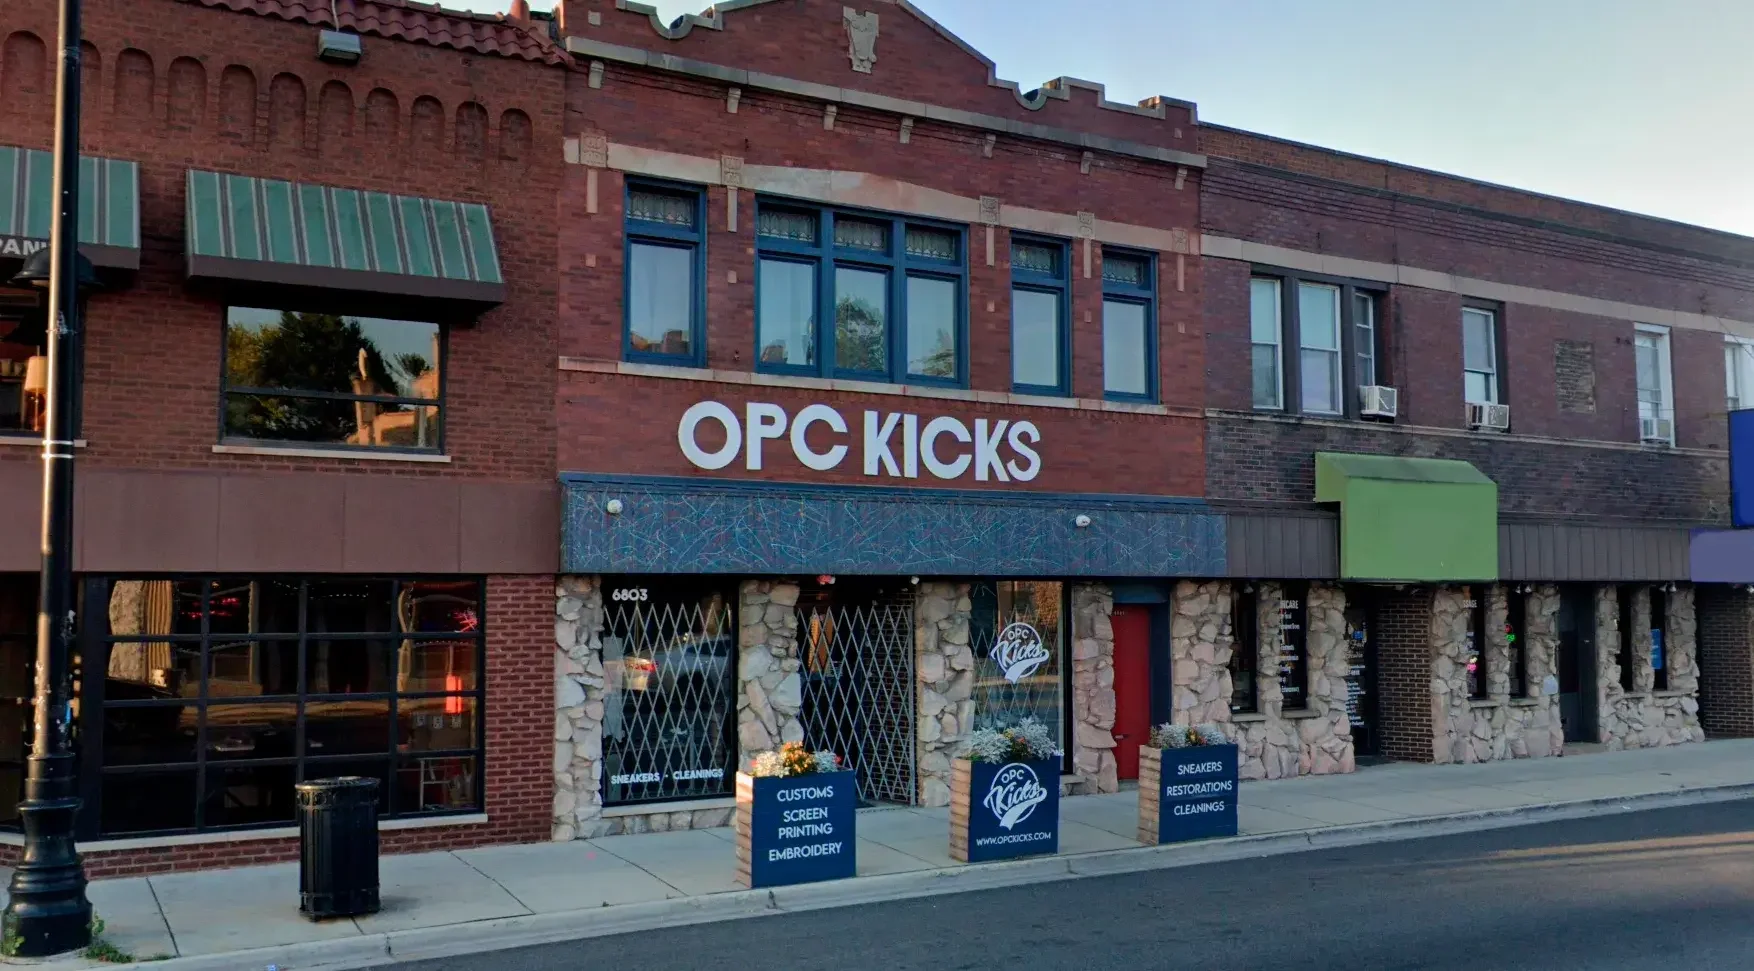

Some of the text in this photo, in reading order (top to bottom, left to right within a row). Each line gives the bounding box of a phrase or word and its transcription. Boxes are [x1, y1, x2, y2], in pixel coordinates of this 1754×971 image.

[678, 401, 1042, 483] OPC KICKS
[611, 588, 648, 601] 6803
[1007, 627, 1030, 640] OPC
[990, 639, 1043, 668] Kicks
[611, 768, 724, 785] SNEAKERS CLEANINGS
[1001, 769, 1025, 784] OPC
[1177, 761, 1223, 775] SNEAKERS
[776, 785, 834, 802] CUSTOMS
[983, 779, 1041, 814] Kicks
[1166, 780, 1233, 797] RESTORATIONS
[783, 807, 828, 822] SCREEN
[1173, 800, 1225, 816] CLEANINGS
[778, 822, 833, 839] PRINTING
[976, 832, 1052, 846] WWW.OPCKICKS.COM
[768, 841, 842, 862] EMBROIDERY
